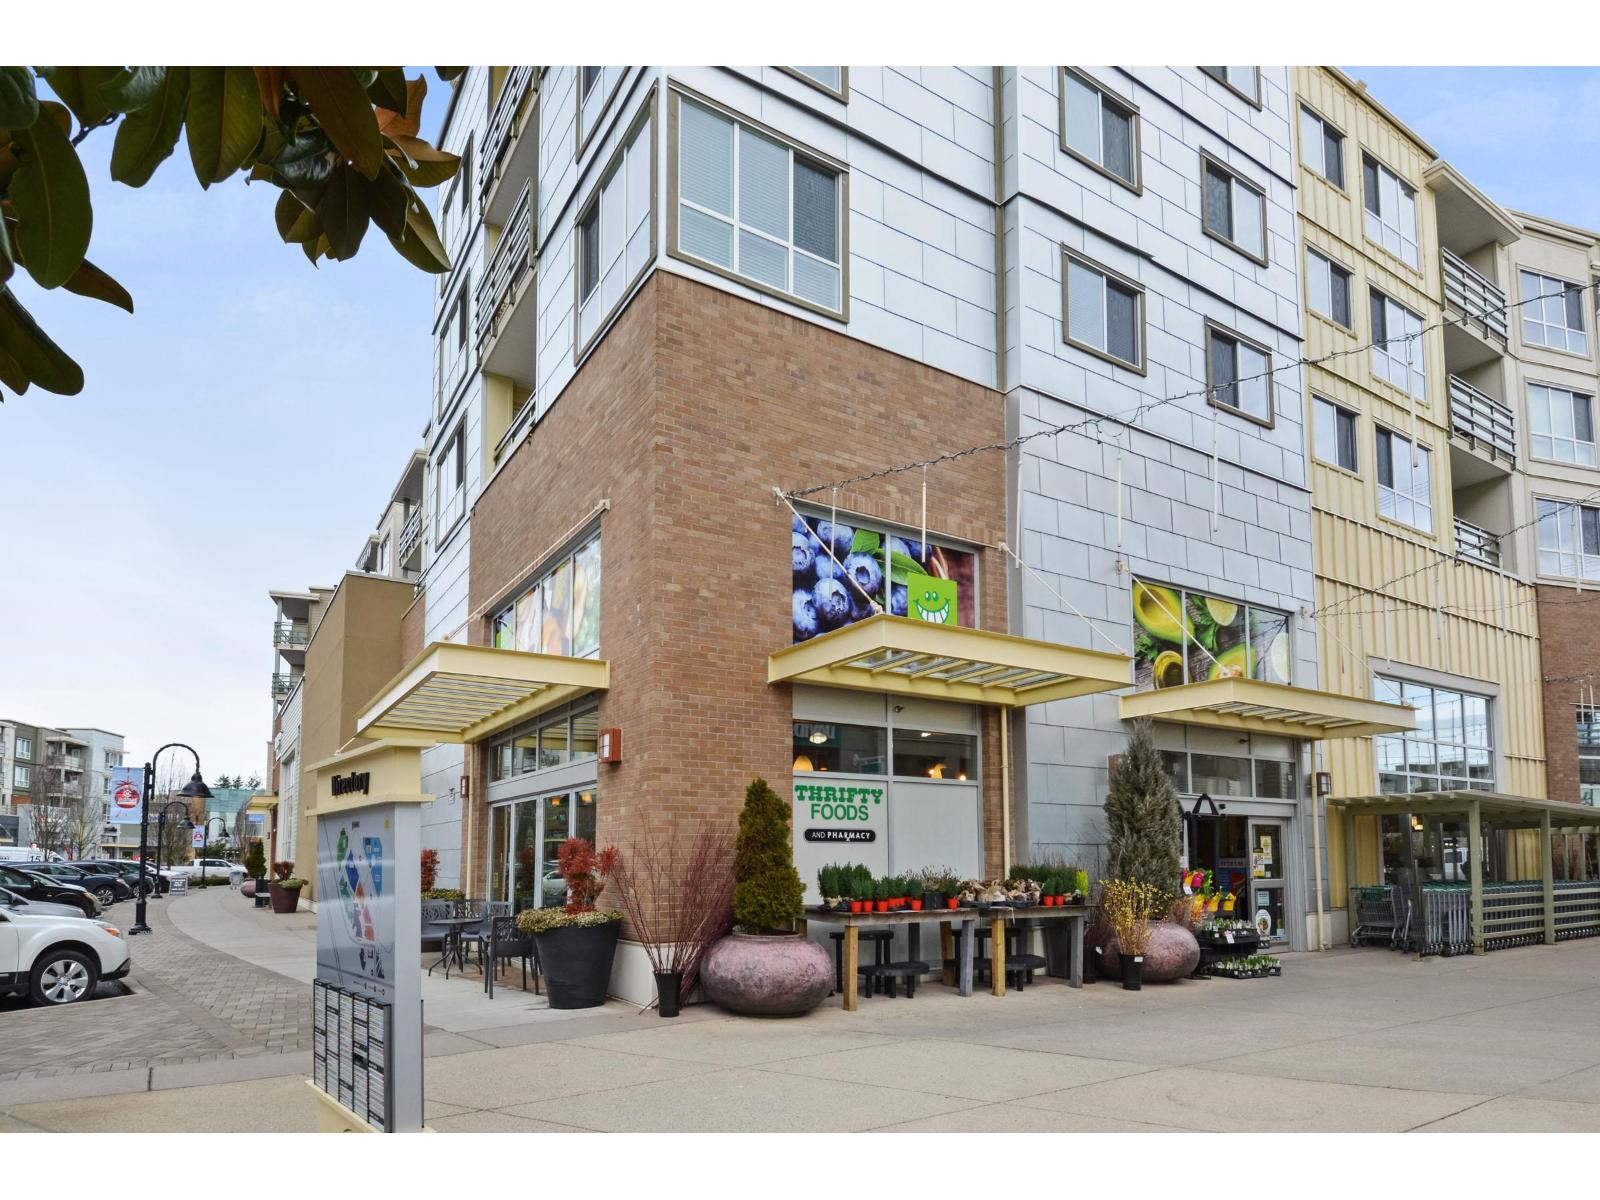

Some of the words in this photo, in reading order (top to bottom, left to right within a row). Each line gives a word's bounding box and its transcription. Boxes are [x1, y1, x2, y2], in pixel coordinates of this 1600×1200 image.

[331, 771, 370, 796] Directory
[794, 785, 883, 804] THRIFTY
[811, 803, 869, 821] FOODS
[811, 831, 826, 839] AND
[827, 831, 871, 842] PHARMACY
